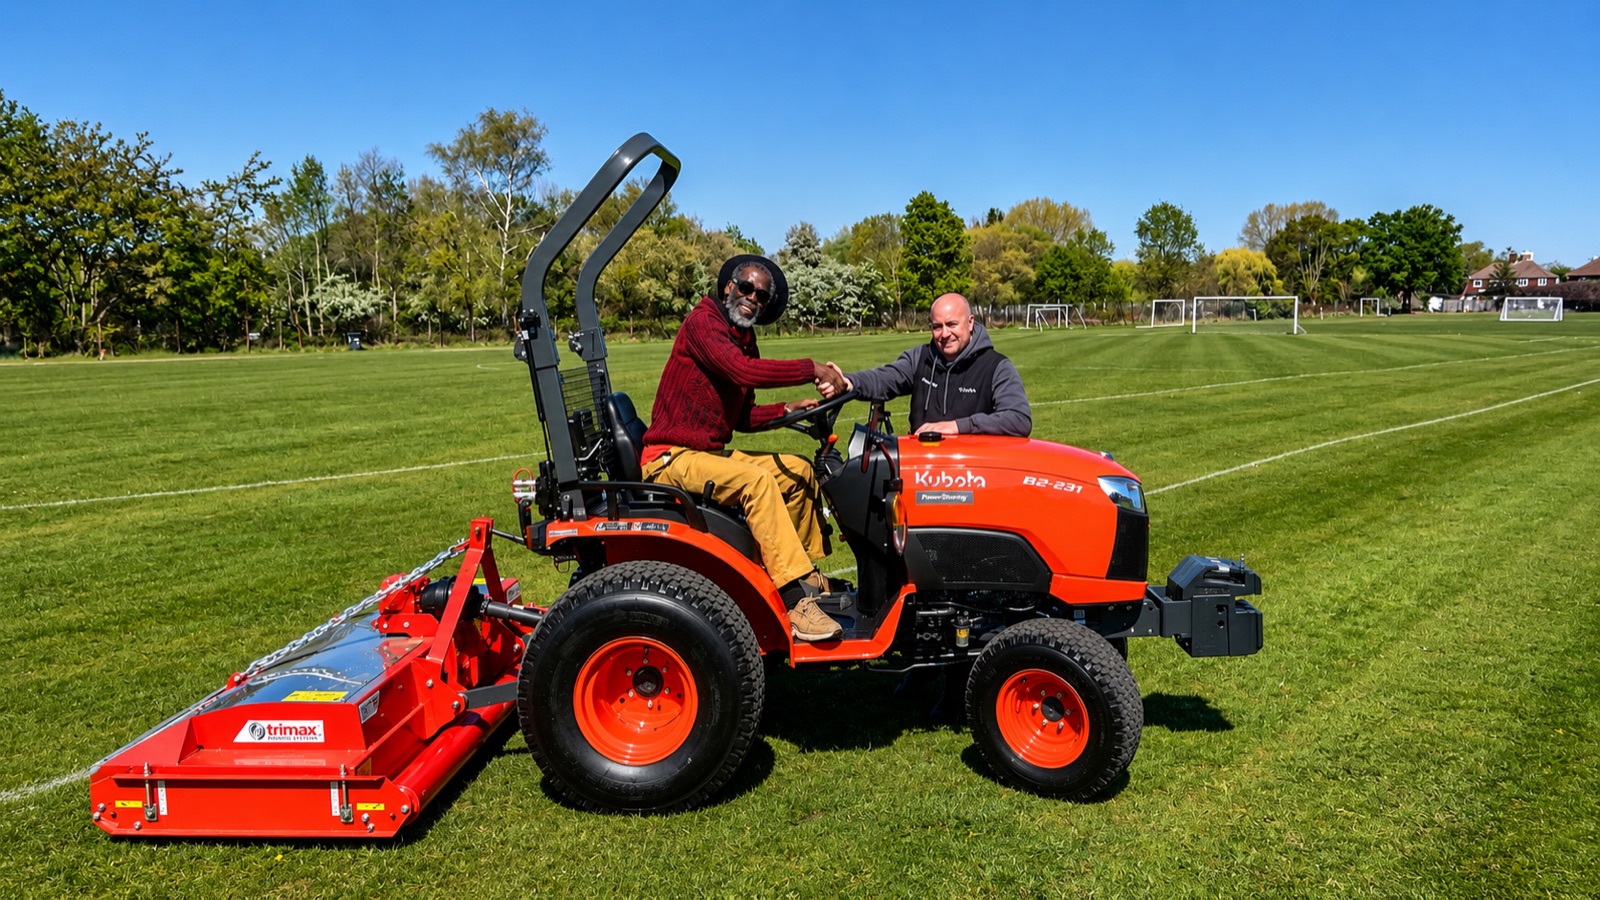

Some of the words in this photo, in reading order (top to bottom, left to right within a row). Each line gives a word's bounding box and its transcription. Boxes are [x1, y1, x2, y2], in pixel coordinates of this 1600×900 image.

[915, 470, 986, 488] Kubota
[1023, 475, 1083, 494] B2-231
[266, 723, 317, 736] trimax
